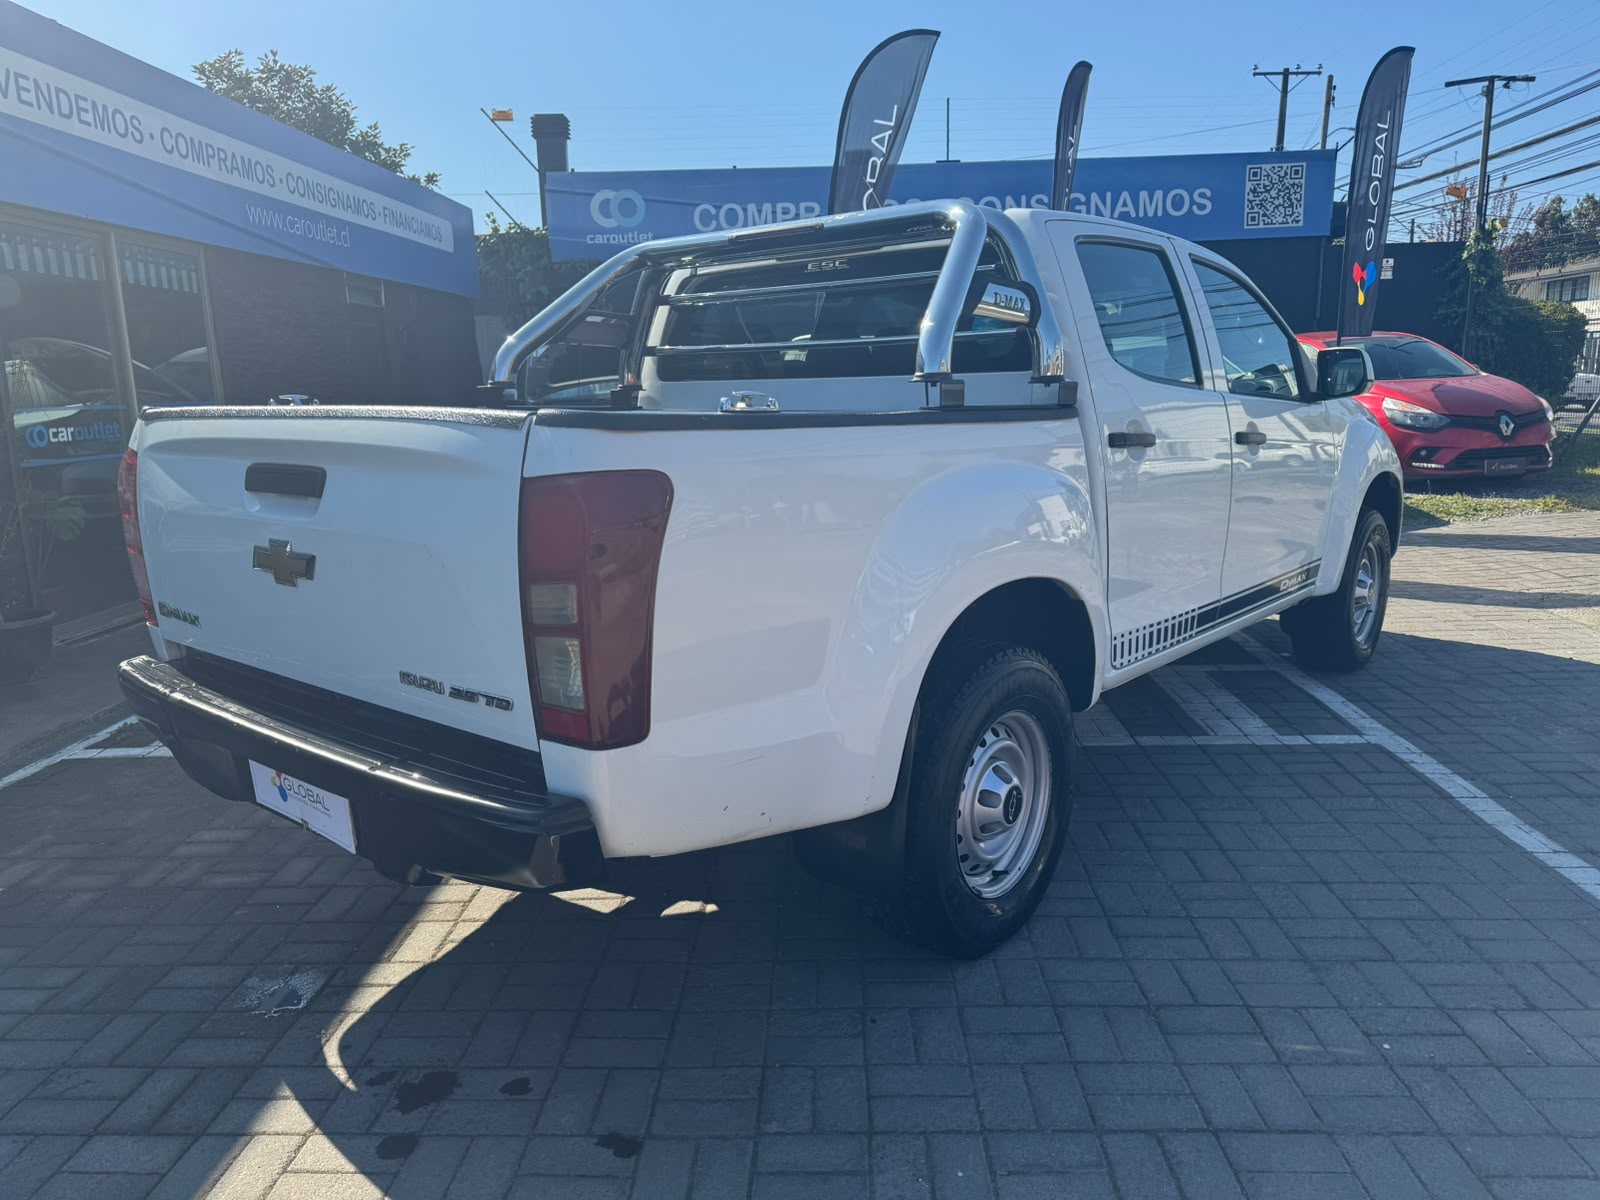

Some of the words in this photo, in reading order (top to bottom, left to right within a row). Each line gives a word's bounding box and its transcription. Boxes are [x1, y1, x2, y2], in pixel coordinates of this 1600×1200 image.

[0, 67, 145, 145] VENDEMOS
[160, 126, 276, 188] COMPRAMOS
[286, 171, 377, 221] CONSIGNAMOS
[383, 206, 443, 243] FINANCIAMOS
[1365, 110, 1391, 251] GLOBAL
[245, 204, 350, 248] www.caroutlet.cl
[586, 231, 654, 244] caroutlet
[399, 670, 445, 695] ISUZU
[283, 777, 330, 812] GLOBAL
